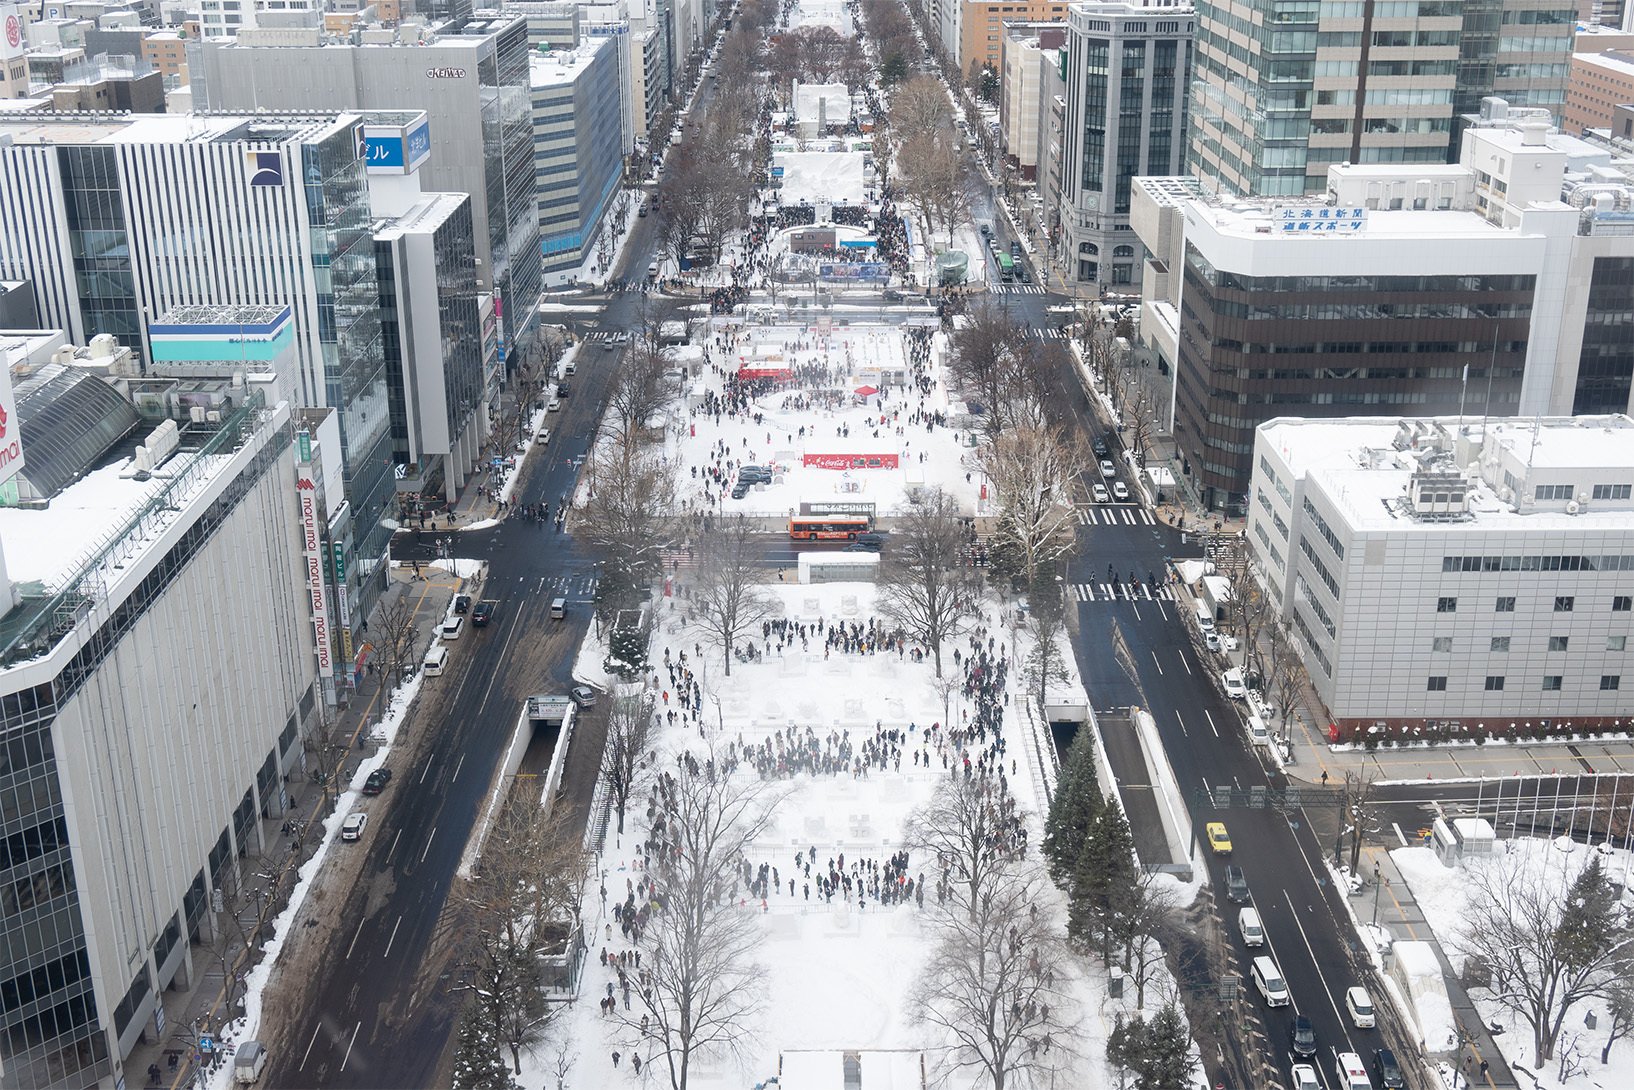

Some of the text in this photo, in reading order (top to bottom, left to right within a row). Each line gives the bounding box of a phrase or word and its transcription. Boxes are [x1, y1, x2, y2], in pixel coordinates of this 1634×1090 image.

[50, 9, 58, 18] P
[1283, 208, 1363, 218] 北海道新聞
[1283, 221, 1362, 230] 道新スポーツ
[303, 498, 316, 552] marui imai
[310, 557, 323, 611] marui imai
[316, 617, 329, 668] marui imai
